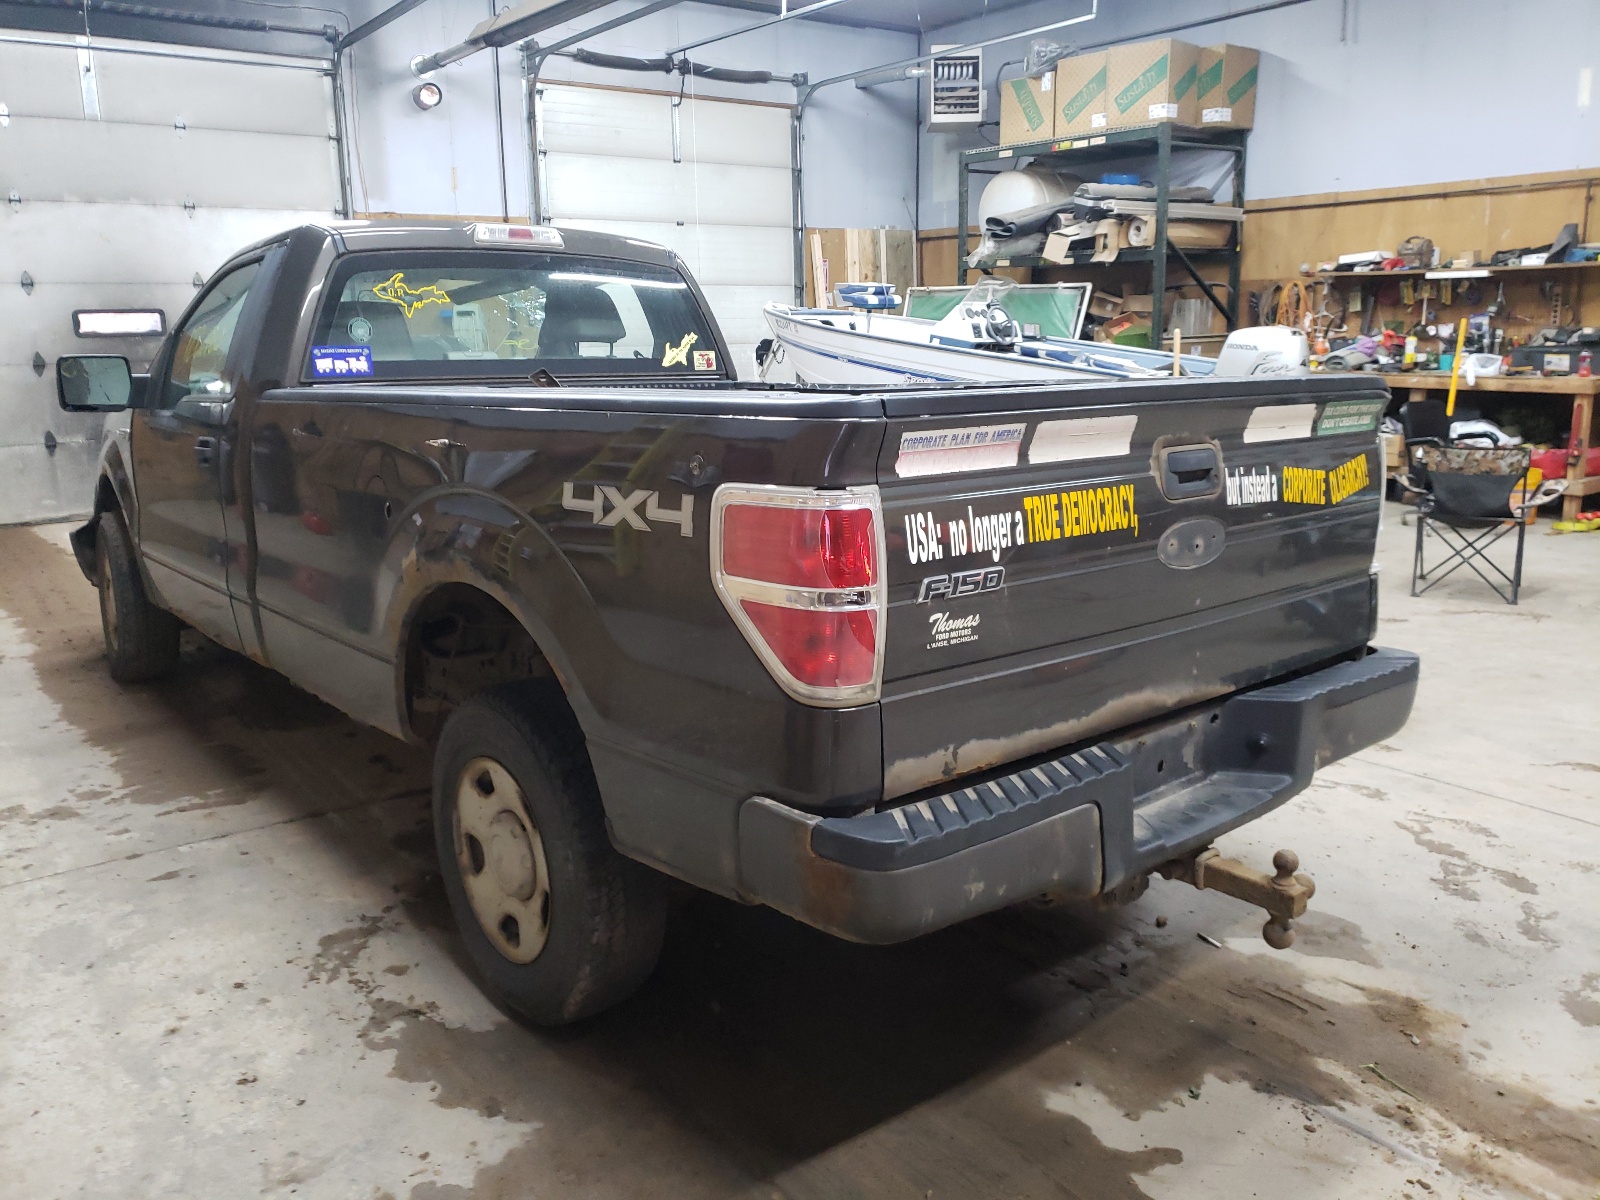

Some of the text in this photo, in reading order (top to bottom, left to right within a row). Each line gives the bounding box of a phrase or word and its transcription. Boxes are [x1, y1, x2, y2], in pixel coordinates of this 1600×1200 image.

[1226, 343, 1259, 351] HONDA
[901, 428, 1022, 451] CORPORATE PLAN FOR AMERICA
[1225, 453, 1370, 506] but instead a CORPORATE OLIGARCHY!
[904, 483, 1139, 565] USA: no longer a TRUE DEMOCRACY,
[916, 565, 1006, 605] F-150
[929, 611, 981, 636] Thomas
[935, 628, 972, 641] FORD MOTORS
[949, 634, 979, 645] MICHIGAN
